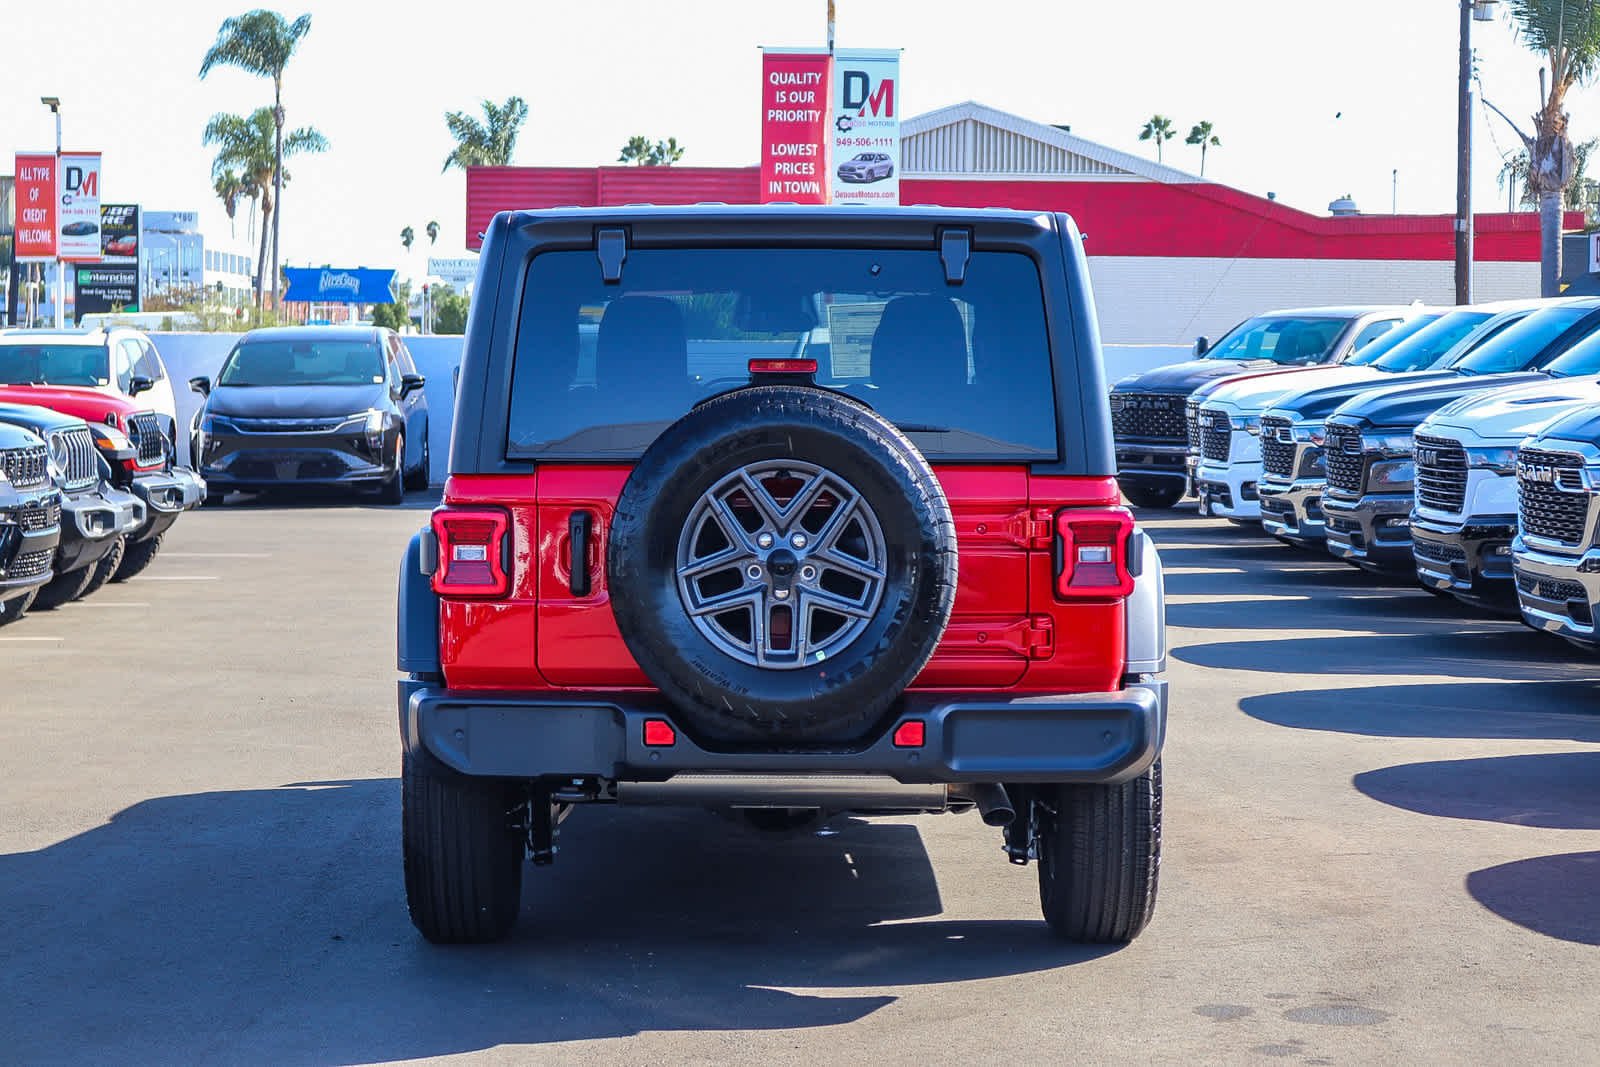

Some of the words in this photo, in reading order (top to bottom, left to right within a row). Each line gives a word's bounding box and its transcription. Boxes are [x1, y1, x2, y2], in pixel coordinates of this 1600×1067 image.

[769, 72, 822, 85] QUALITY
[776, 91, 788, 103] IS
[789, 91, 815, 103] OUR
[768, 109, 821, 122] PRIORITY
[836, 137, 893, 147] 949-506-1111
[771, 143, 818, 156] LOWEST
[20, 167, 32, 181] ALL
[33, 167, 50, 181] TYPE
[774, 162, 815, 175] PRICES
[769, 181, 782, 193] IN
[784, 181, 820, 194] TOWN
[29, 187, 39, 202] OF
[23, 208, 47, 223] CREDIT
[19, 229, 51, 243] WELCOME
[81, 271, 135, 283] enterprise
[1125, 401, 1171, 409] RAM
[1516, 461, 1552, 481] RAM
